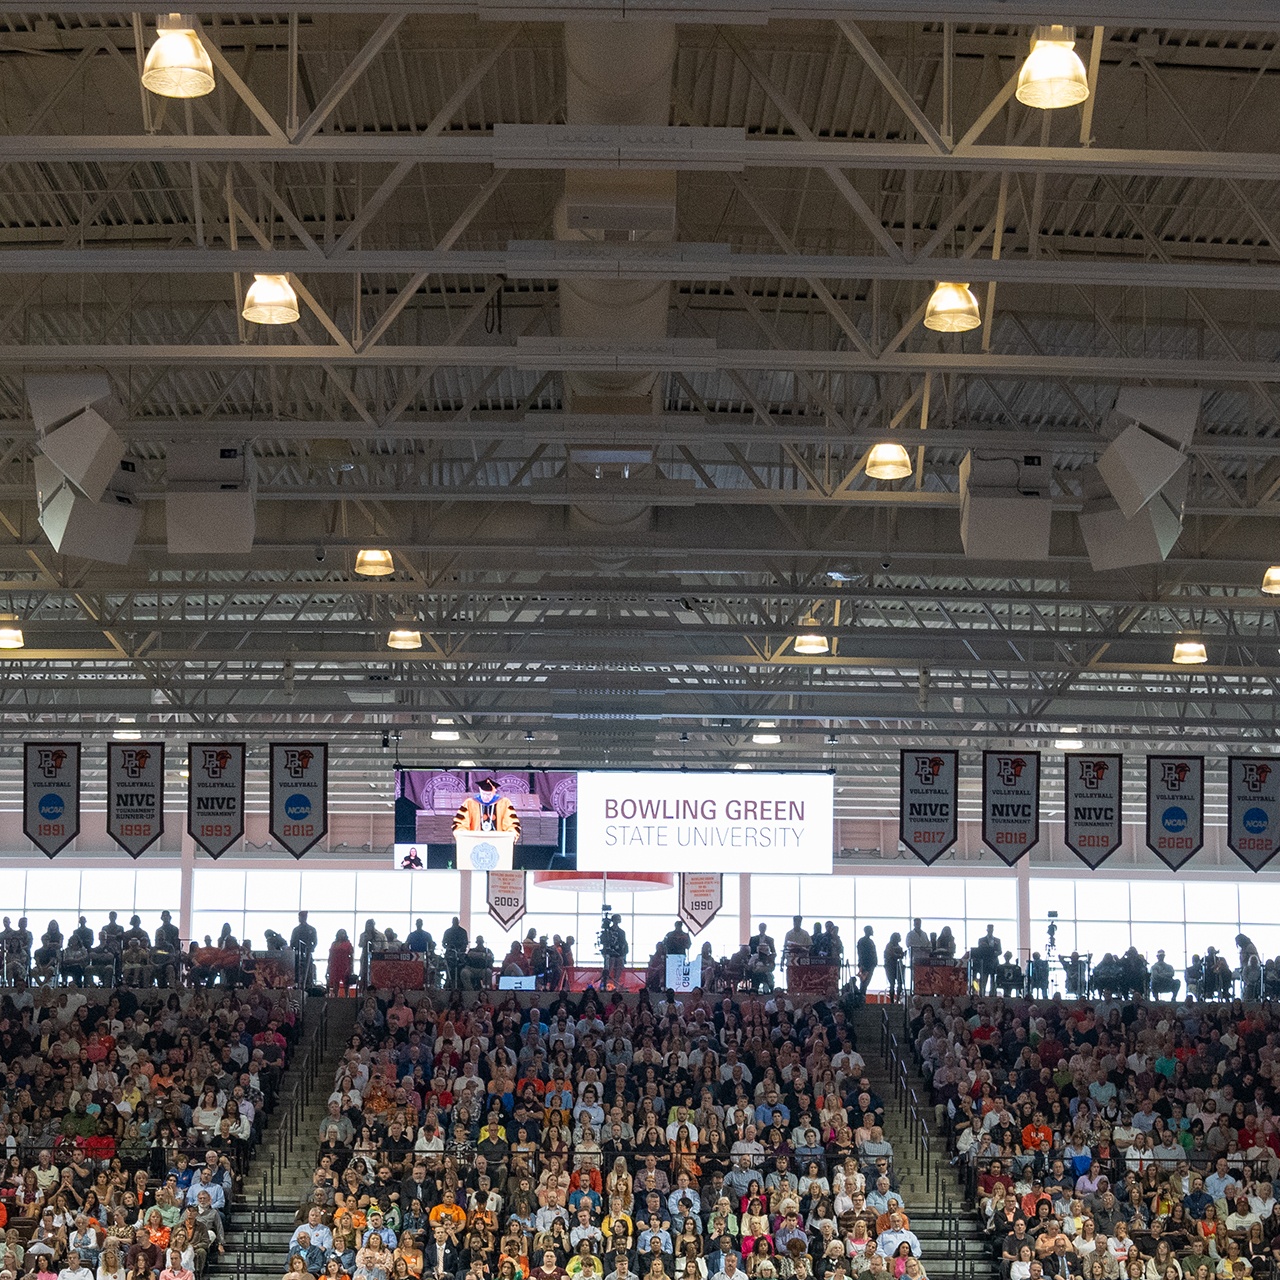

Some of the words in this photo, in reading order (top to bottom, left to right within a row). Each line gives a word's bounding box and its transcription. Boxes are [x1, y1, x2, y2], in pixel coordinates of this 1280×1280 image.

[116, 794, 155, 806] NIVC
[196, 797, 236, 809] NIVC
[41, 806, 63, 814] NCAA
[287, 806, 311, 814] NCAA
[605, 799, 715, 821] BOWLING
[726, 800, 805, 821] GREEN
[909, 803, 949, 816] NIVC
[992, 804, 1031, 817] NIVC
[1074, 808, 1114, 820] NIVC
[38, 824, 65, 836] 1991
[120, 824, 151, 836] 1992
[201, 824, 232, 836] 1993
[283, 824, 314, 836] 2012
[1246, 820, 1267, 828] NCAA
[605, 826, 669, 847] STATE
[677, 826, 806, 848] UNIVERSITY
[914, 832, 945, 843] 2017
[996, 832, 1027, 844] 2018
[1078, 835, 1109, 847] 2019
[1158, 837, 1192, 849] 2020
[1239, 838, 1272, 850] 2022
[494, 897, 519, 907] 2003
[691, 901, 713, 910] 1990
